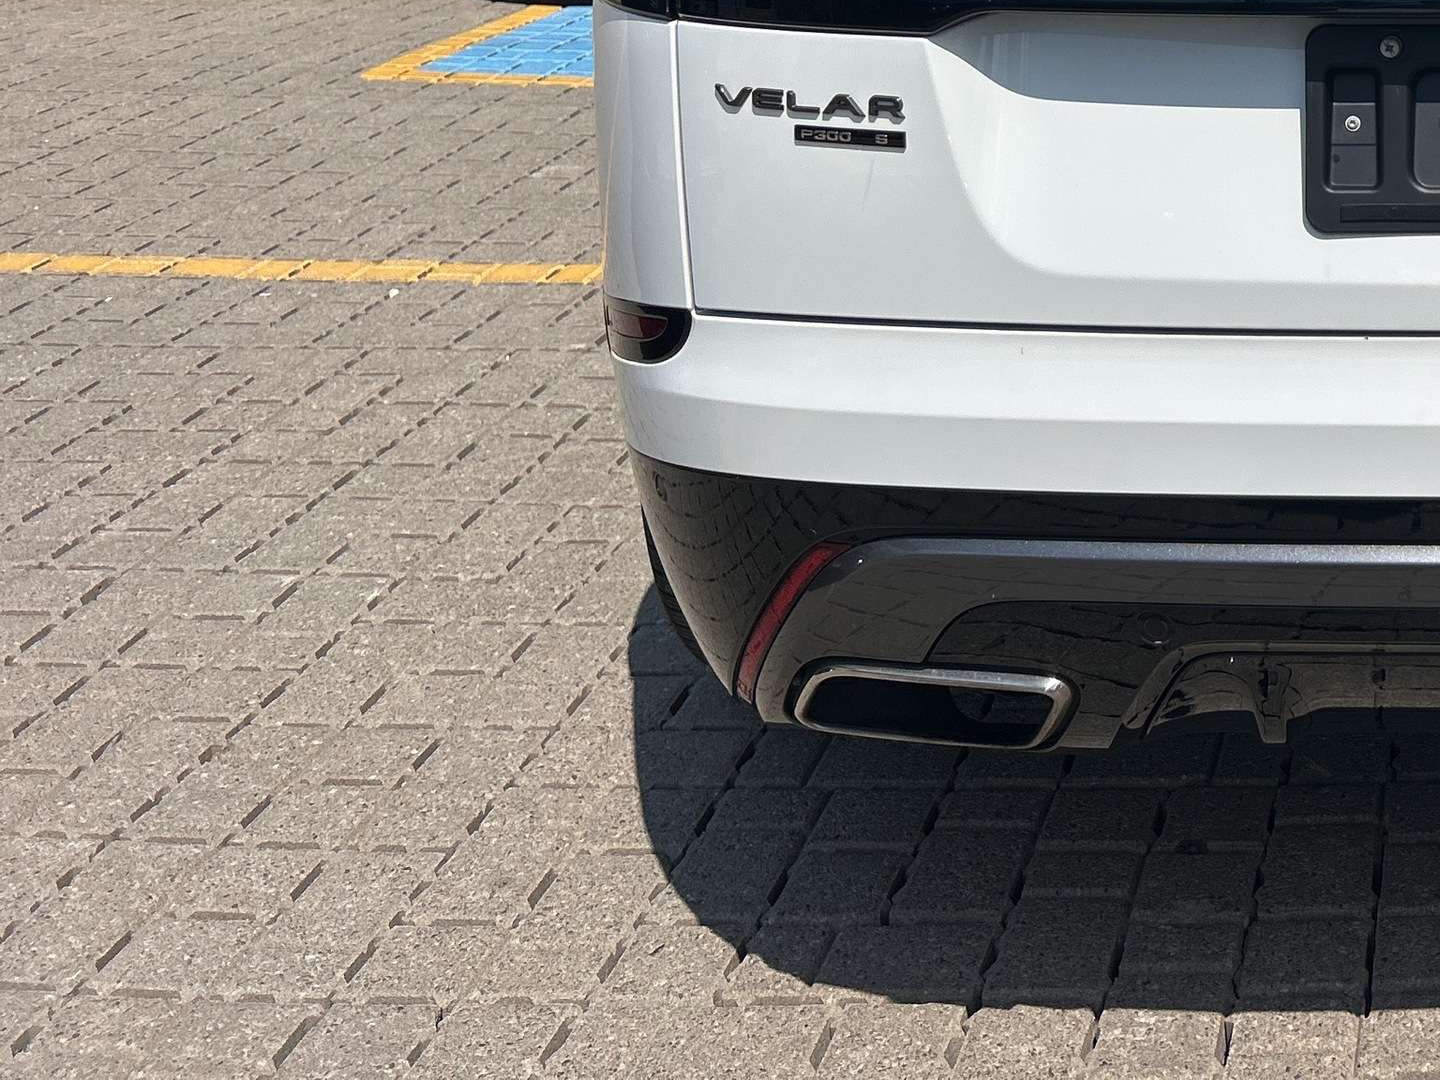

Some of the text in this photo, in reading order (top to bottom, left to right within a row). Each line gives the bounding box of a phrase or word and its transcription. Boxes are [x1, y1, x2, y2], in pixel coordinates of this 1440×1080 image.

[714, 83, 906, 125] VELAR
[800, 128, 889, 145] P300 S
